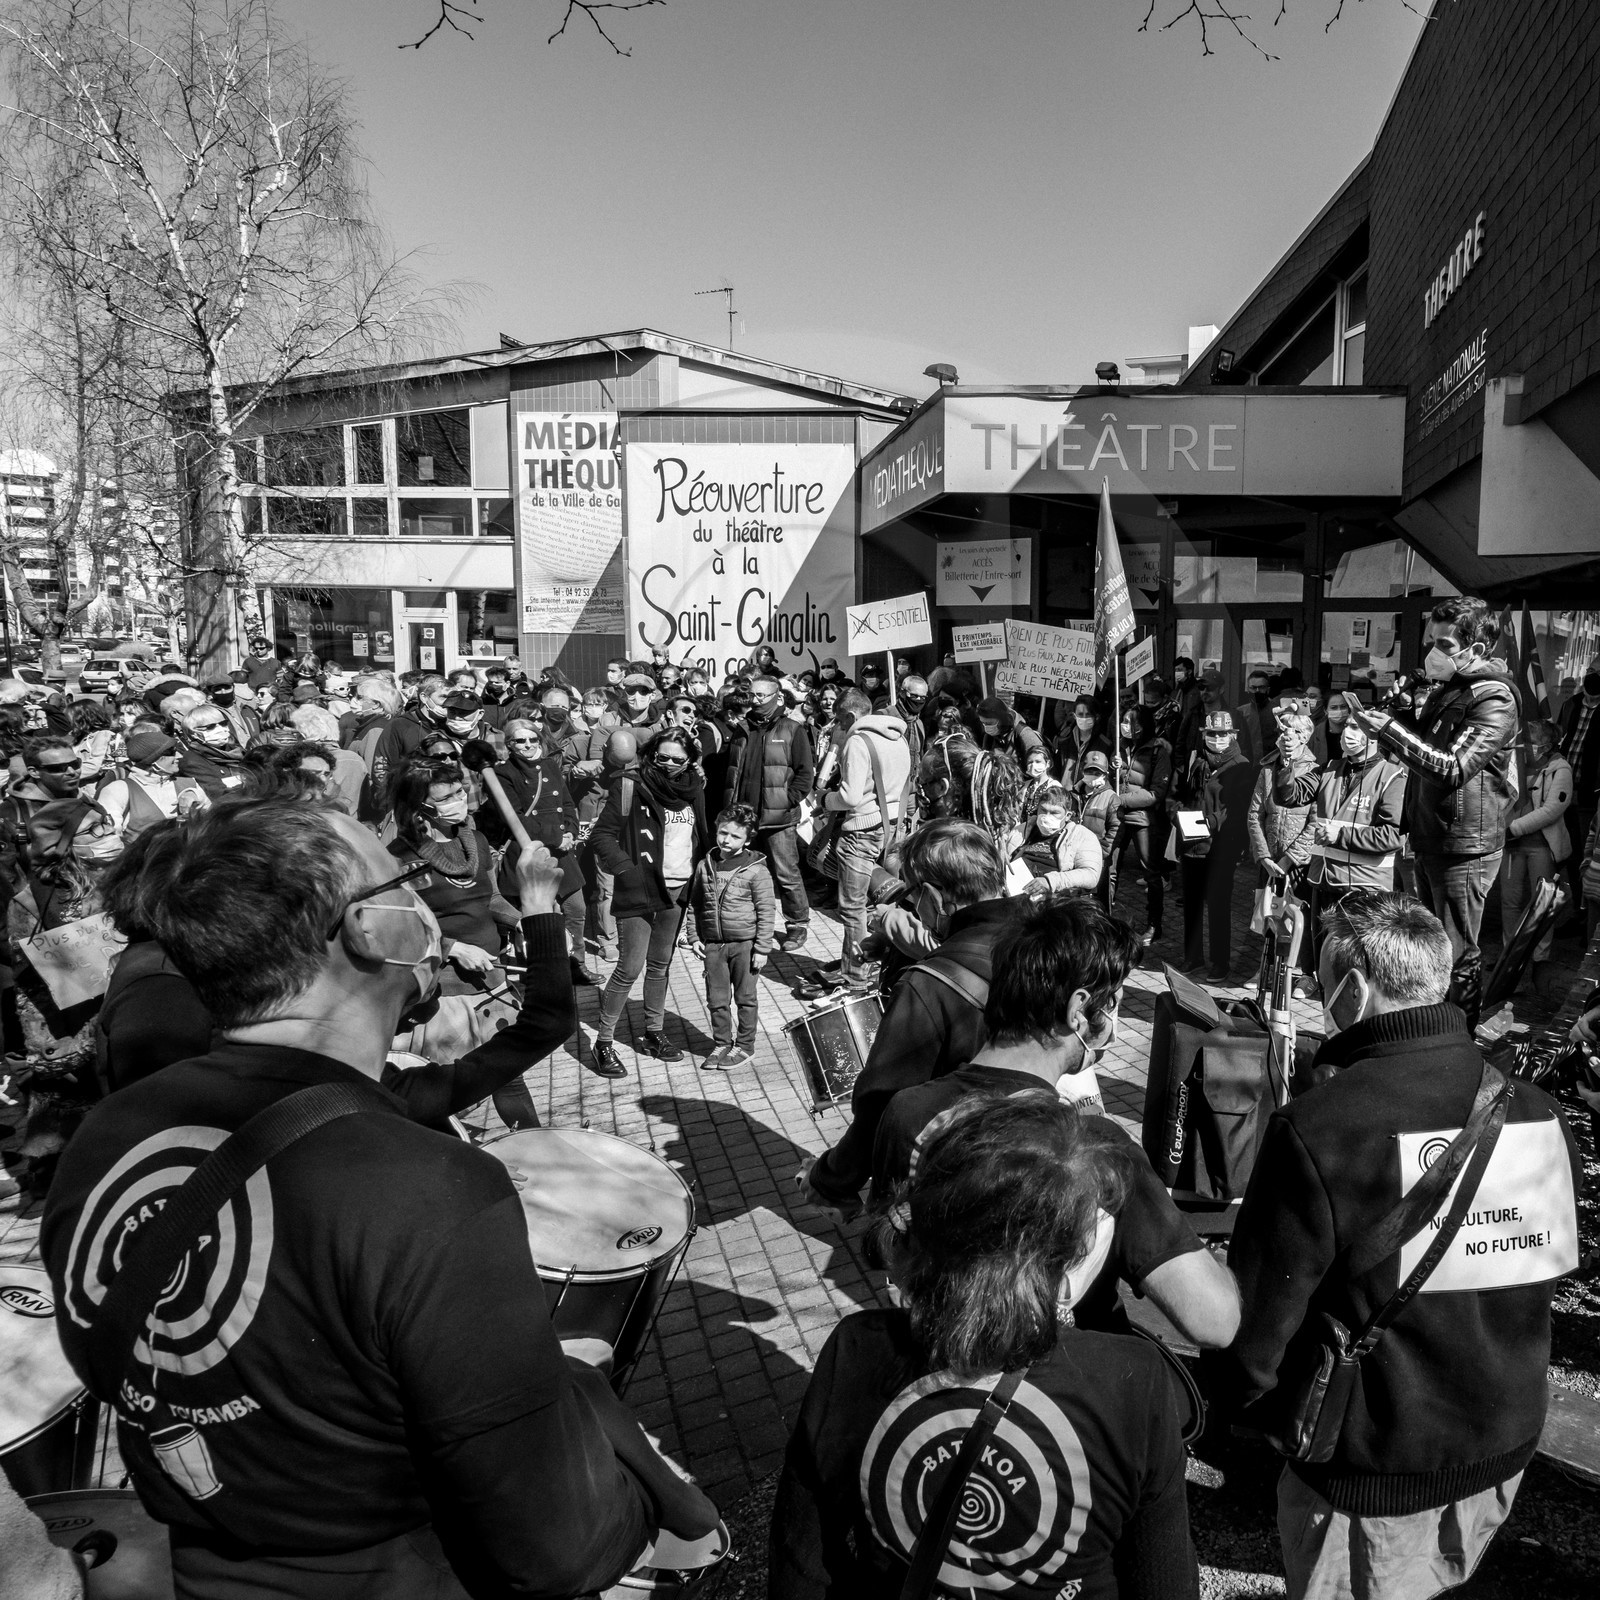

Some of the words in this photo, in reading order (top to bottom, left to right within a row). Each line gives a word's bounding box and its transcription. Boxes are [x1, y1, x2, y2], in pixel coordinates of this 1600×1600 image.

[1442, 328, 1488, 396] NATIONALE
[524, 450, 621, 492] THÈQU
[532, 492, 545, 507] de
[549, 492, 559, 507] la
[562, 493, 585, 507] Ville
[588, 493, 602, 507] de
[653, 457, 825, 523] Réouverture
[692, 519, 713, 543] du
[726, 519, 784, 544] théâtre
[712, 548, 725, 575] à
[743, 546, 759, 575] la
[972, 556, 993, 568] ACCÈS
[945, 571, 979, 581] Billetterie
[985, 570, 1022, 580] Entre-sort
[955, 634, 961, 642] LE
[962, 632, 992, 642] PRINTEMPS
[971, 638, 1003, 647] INEXORABLE
[1035, 631, 1049, 646] DE
[1052, 633, 1073, 650] PLUS
[1076, 638, 1096, 655] FUTIL
[1019, 661, 1027, 671] DE
[1030, 663, 1047, 674] PLUS
[1056, 652, 1069, 663] DE
[997, 671, 1018, 684] QUE
[1024, 675, 1037, 686] LE
[627, 1228, 655, 1248] RMV
[1465, 1241, 1488, 1256] NO
[1492, 1233, 1544, 1253] FUTURE
[3, 1290, 53, 1311] RMV
[923, 1439, 1028, 1495] BATKOA
